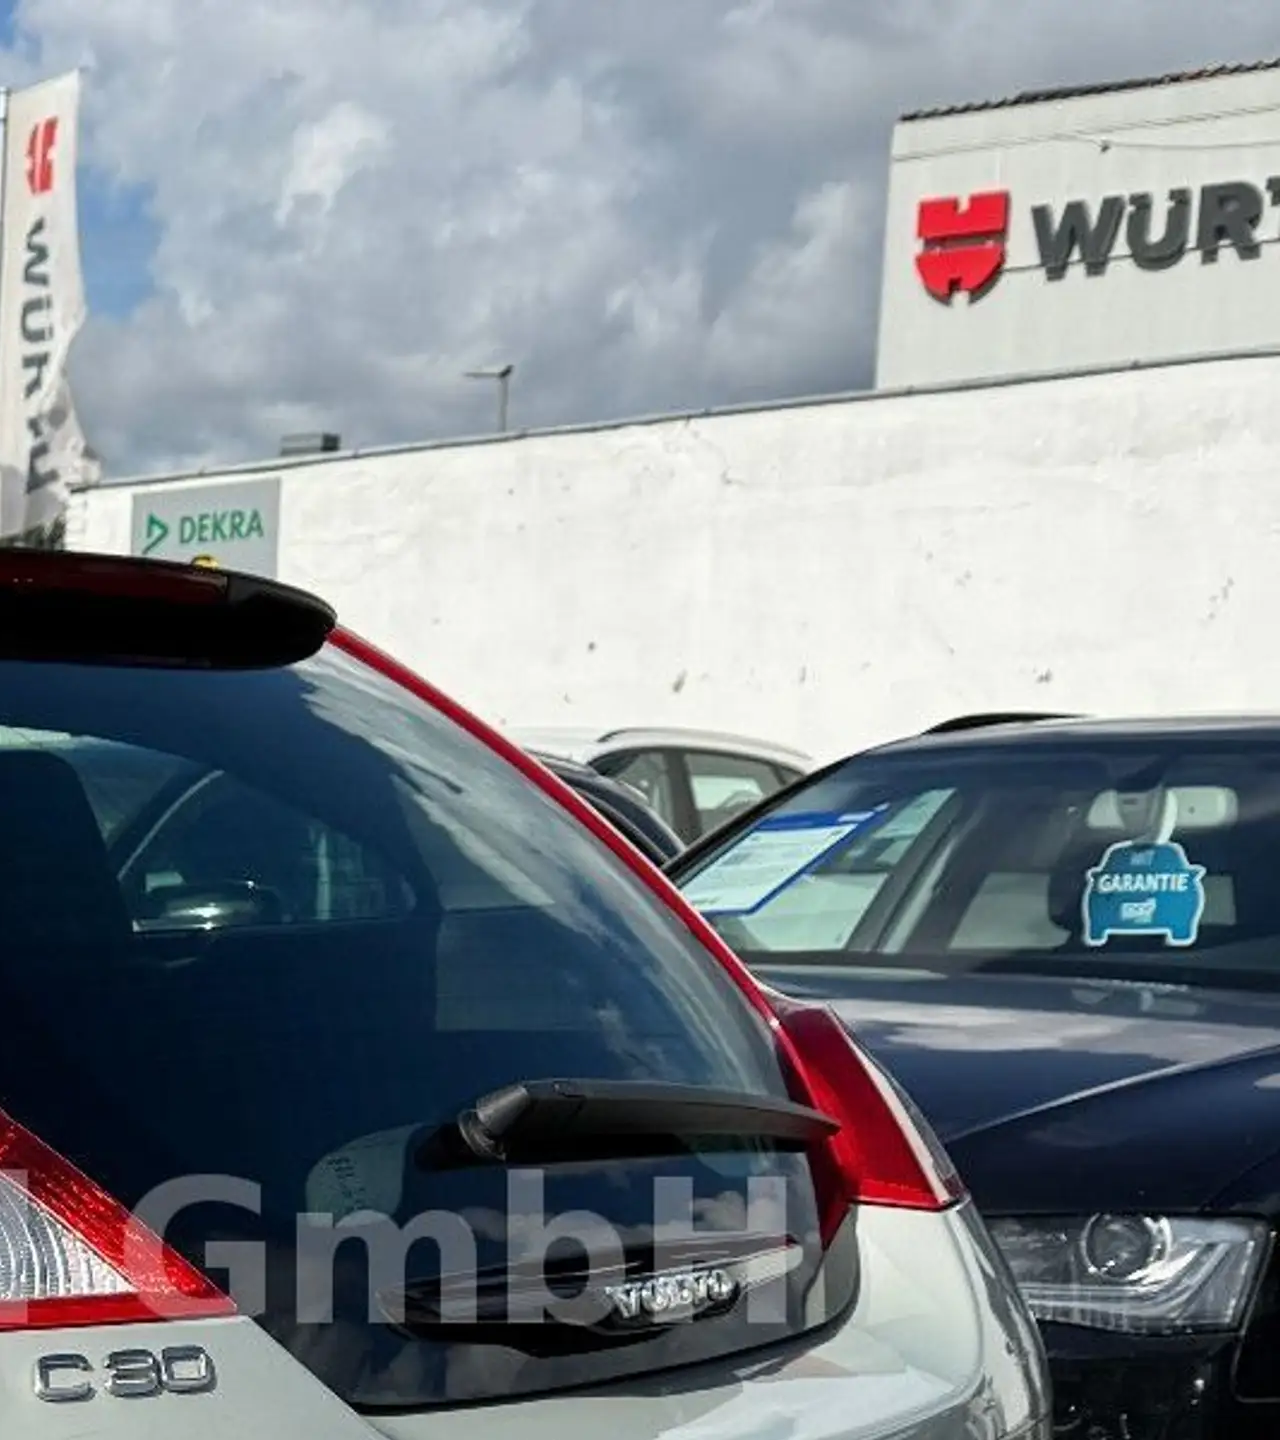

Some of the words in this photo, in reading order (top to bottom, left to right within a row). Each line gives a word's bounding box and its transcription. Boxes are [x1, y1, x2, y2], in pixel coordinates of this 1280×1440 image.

[179, 508, 265, 545] DEKRA
[1098, 872, 1191, 893] GARANTIE
[32, 1344, 217, 1403] C30
